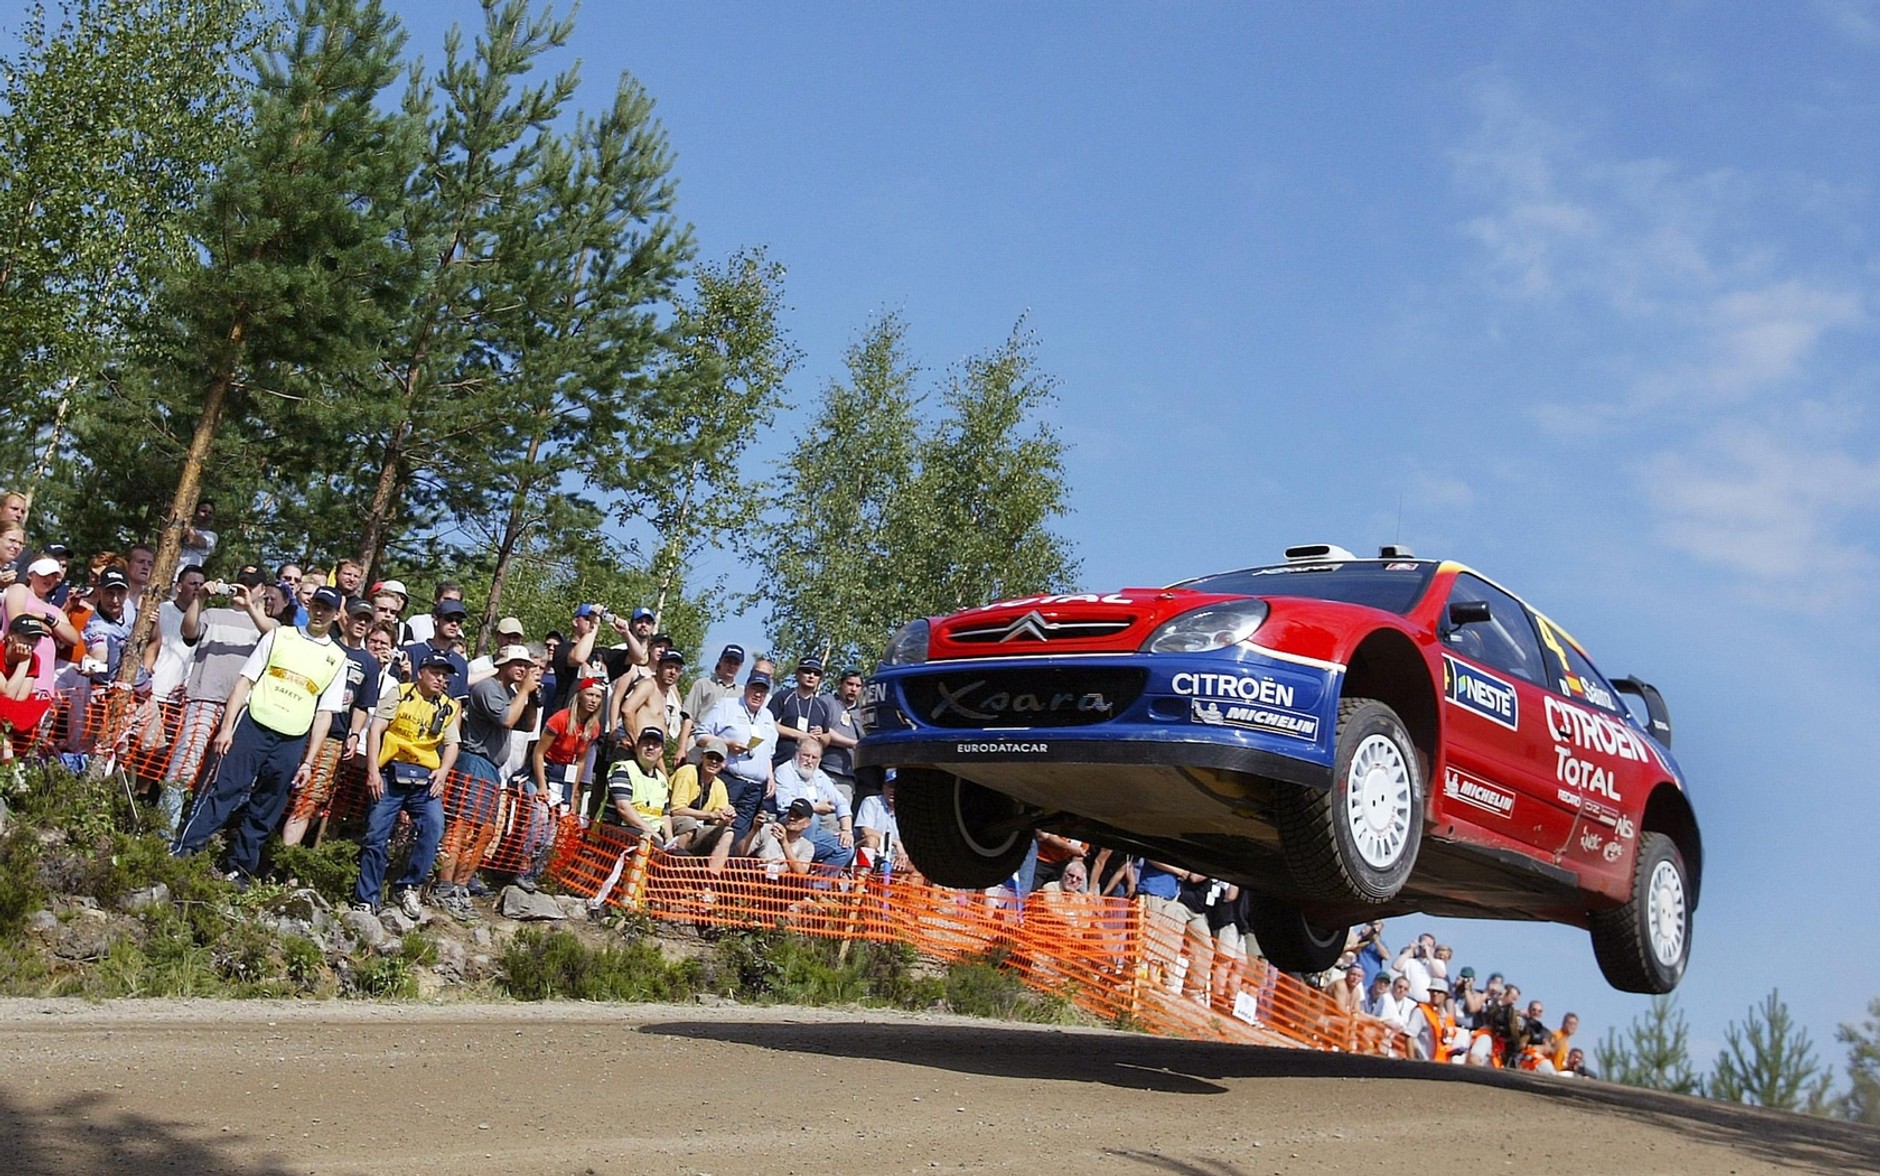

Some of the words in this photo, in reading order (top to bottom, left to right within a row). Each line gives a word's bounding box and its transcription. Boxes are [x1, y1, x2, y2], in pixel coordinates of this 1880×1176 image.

[1535, 615, 1570, 671] 4
[931, 680, 1113, 720] Xsara
[1172, 673, 1294, 707] CITROËN
[1466, 675, 1511, 717] NESTE
[1226, 707, 1316, 734] MICHELIN
[1543, 695, 1649, 763] CITROËN
[957, 743, 1049, 753] EURODATACAR
[1554, 745, 1621, 802] TOTAL
[1460, 780, 1514, 811] MICHELIN
